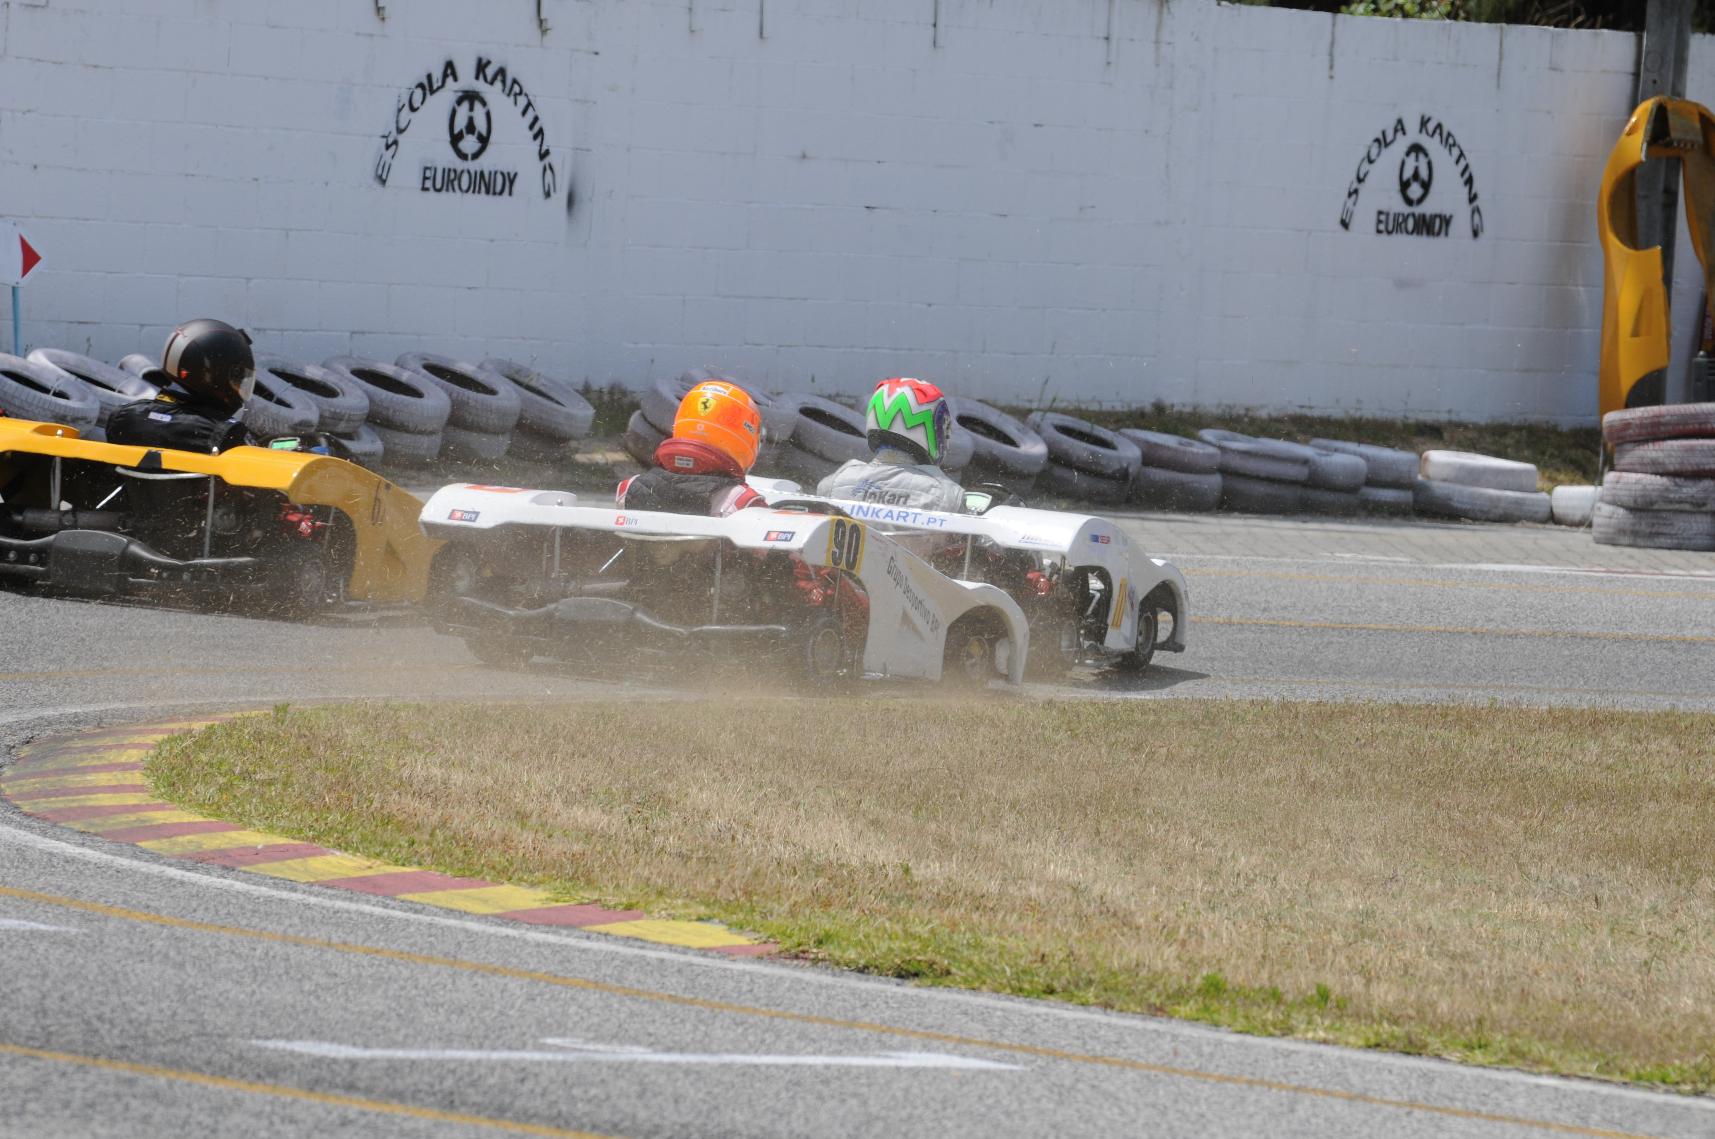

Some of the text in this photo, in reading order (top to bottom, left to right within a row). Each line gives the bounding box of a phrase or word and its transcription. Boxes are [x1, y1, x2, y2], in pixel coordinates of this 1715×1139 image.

[374, 56, 557, 199] ESCOLA KARTING
[420, 166, 518, 197] EUROINDY
[1340, 114, 1484, 239] ESCOLA KARTING
[1375, 210, 1453, 237] EUROINDY
[831, 518, 861, 571] 90
